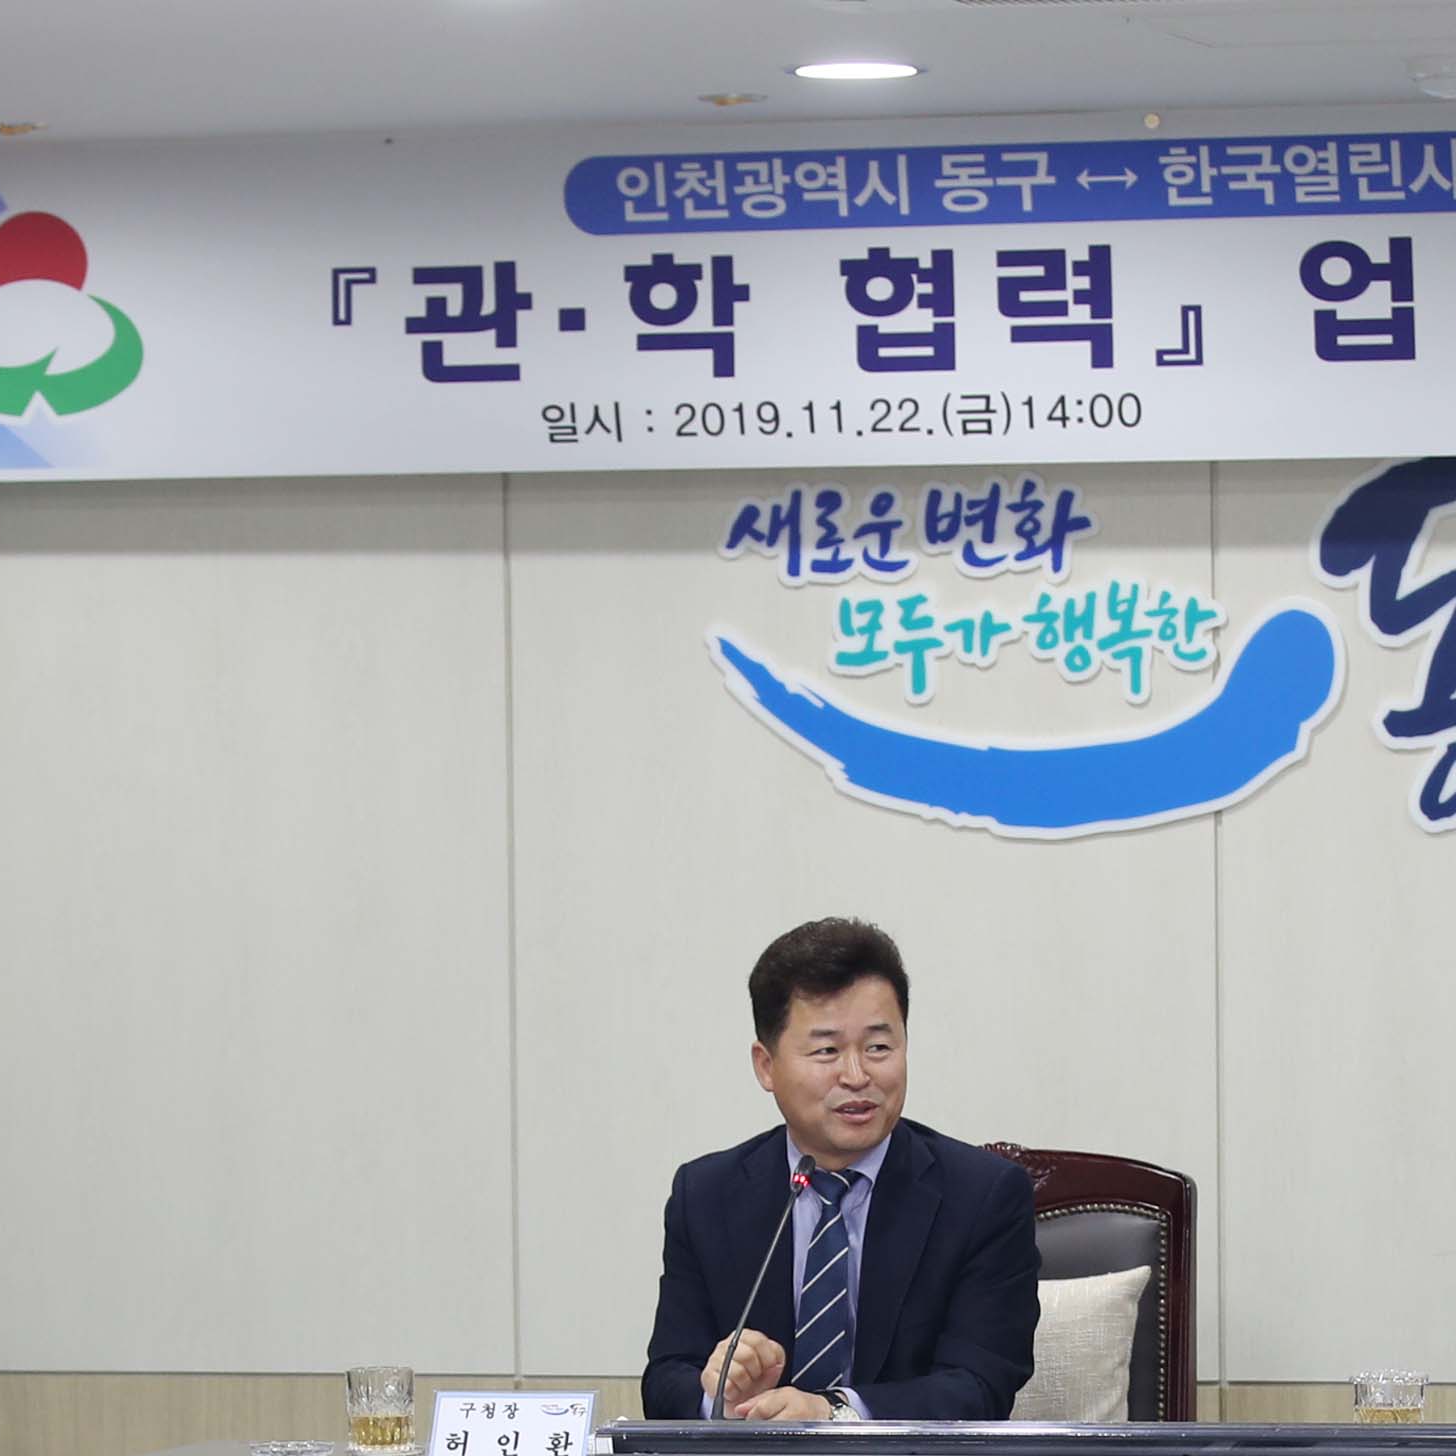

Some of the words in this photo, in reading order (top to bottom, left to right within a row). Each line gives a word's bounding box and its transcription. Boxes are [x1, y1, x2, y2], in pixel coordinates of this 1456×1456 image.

[615, 155, 911, 219] 인천광역시
[934, 153, 1057, 213] 동구
[839, 244, 1204, 373] 협력』
[541, 402, 624, 444] 일시
[727, 491, 908, 576] 새로운
[925, 481, 1092, 573] 변화
[836, 595, 1012, 695] 모두가
[1034, 584, 1217, 694] 행복한
